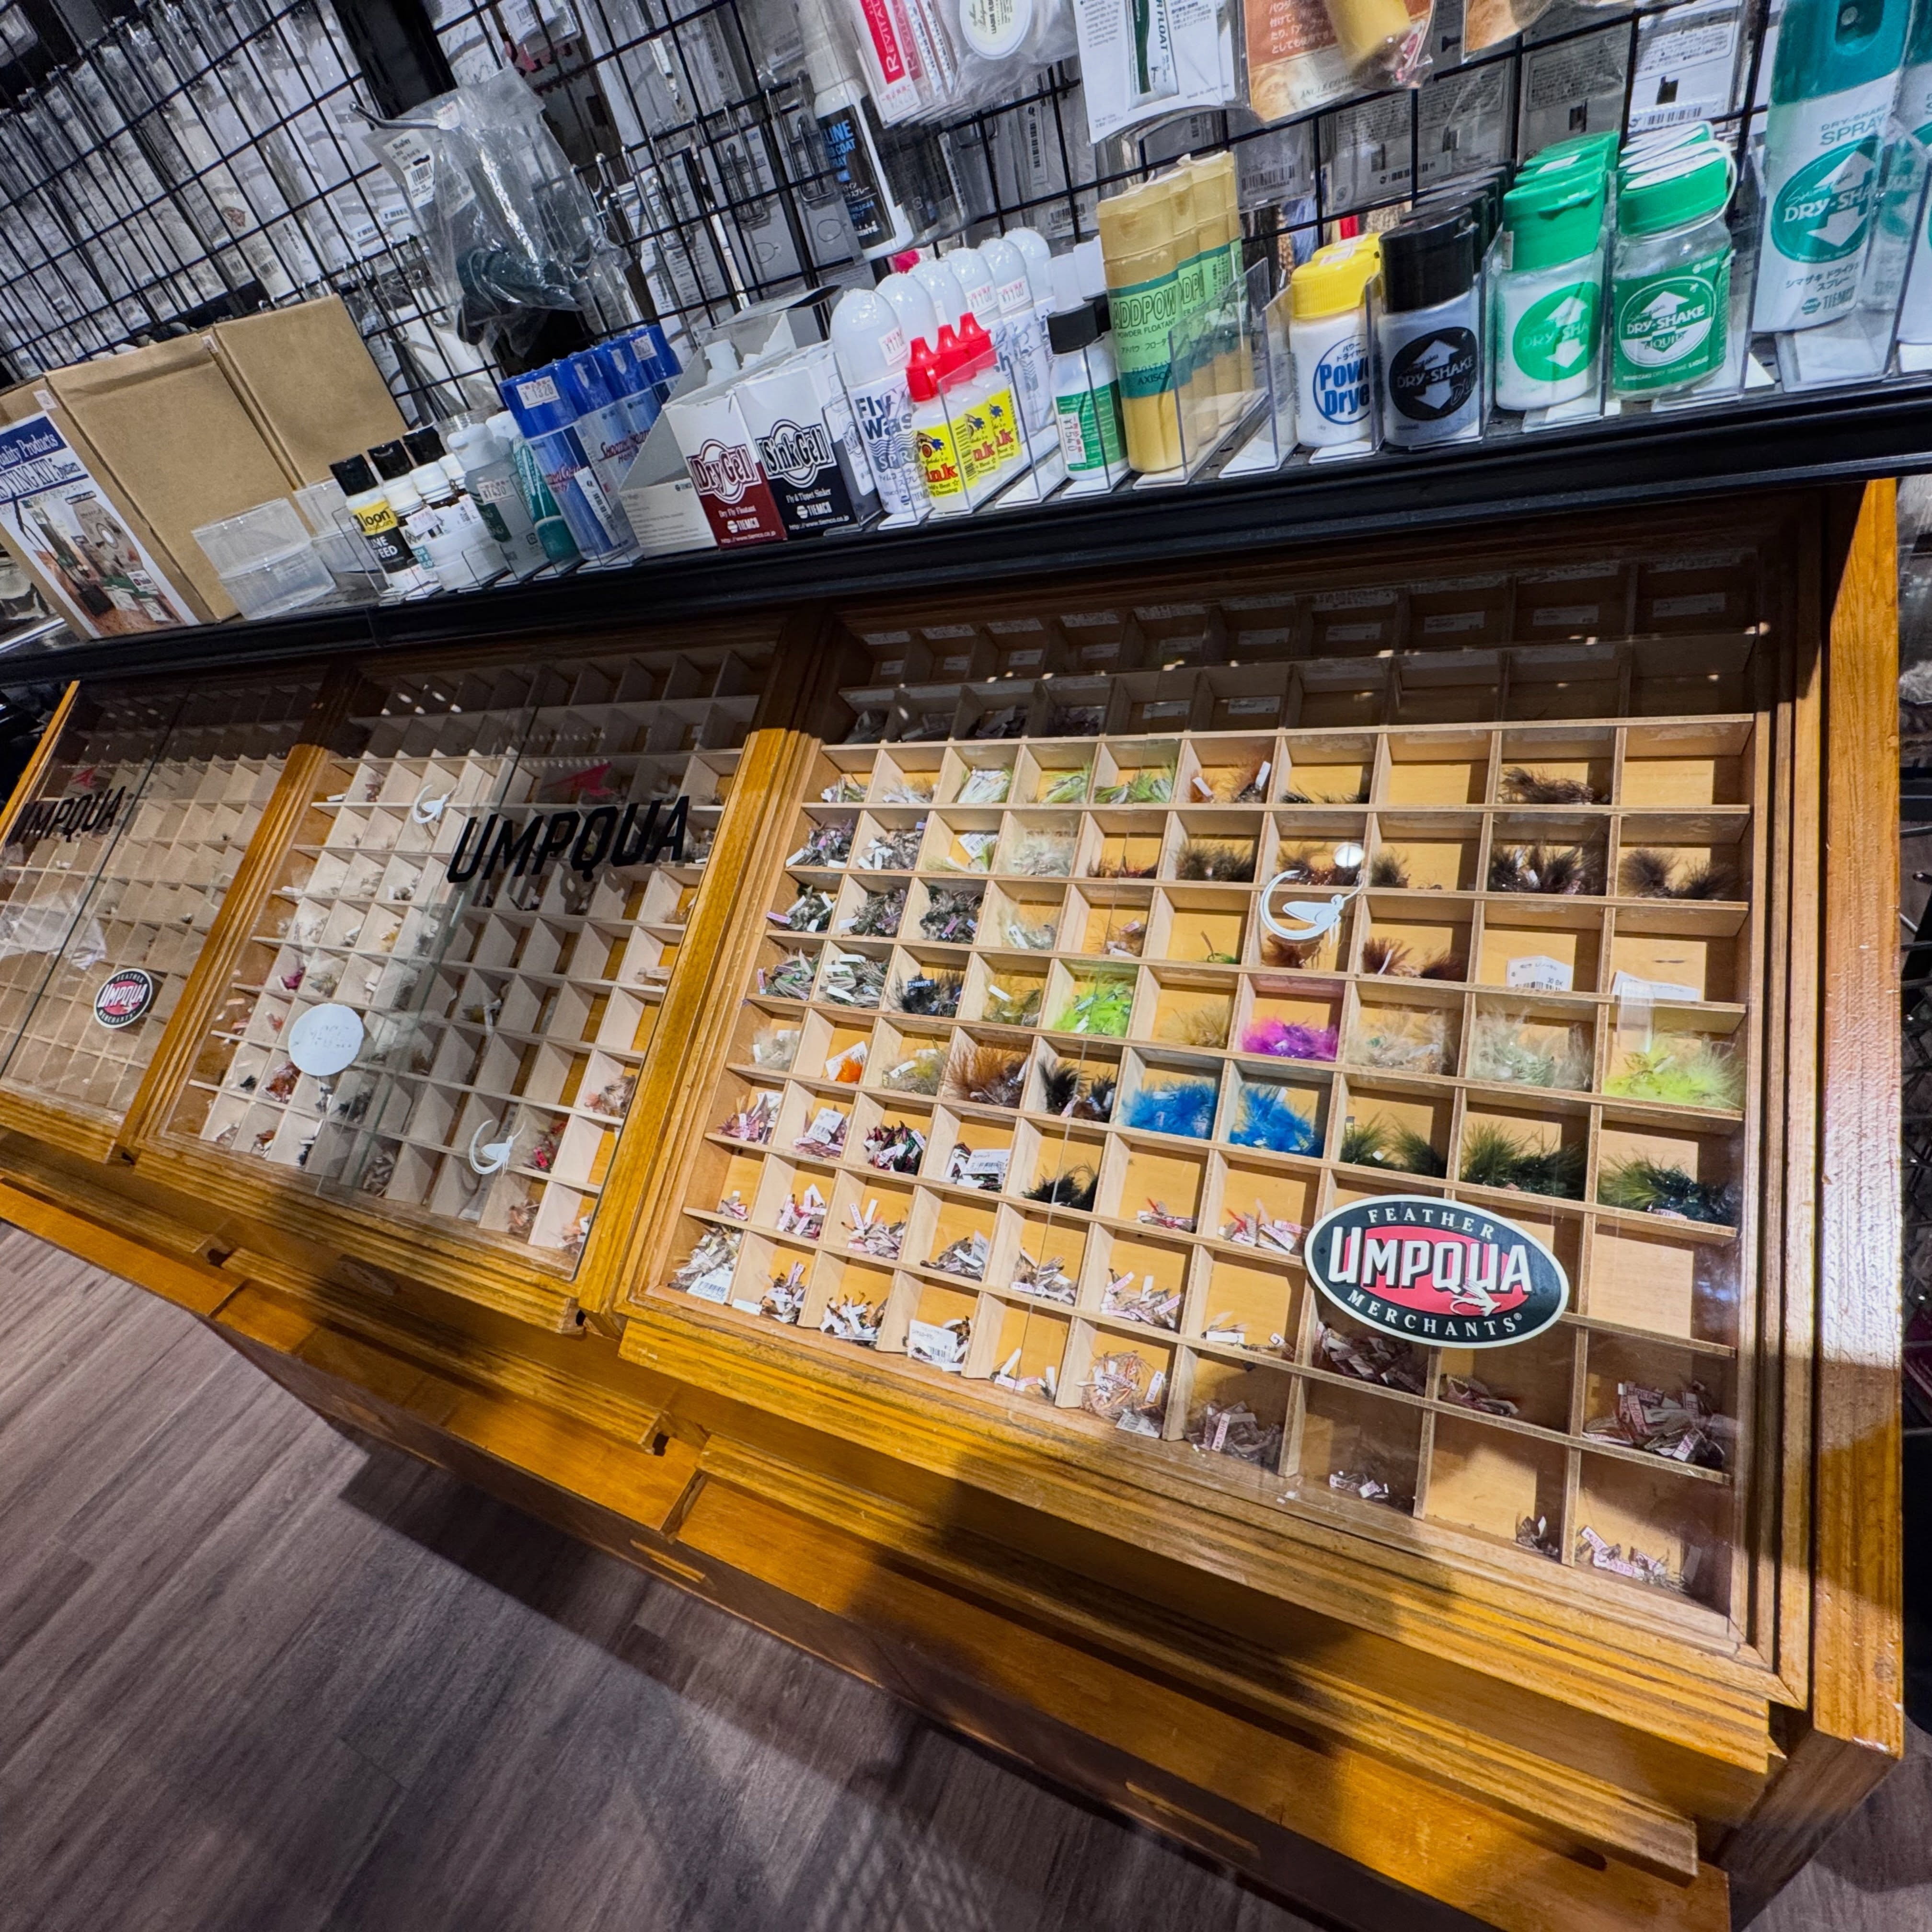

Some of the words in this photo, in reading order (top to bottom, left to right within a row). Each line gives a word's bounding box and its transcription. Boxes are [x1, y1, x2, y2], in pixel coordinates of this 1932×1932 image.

[1156, 11, 1168, 51] FLOAT
[1819, 114, 1886, 146] SPRAY
[1626, 304, 1706, 335] DRY-SHAKE
[1641, 330, 1688, 350] LIQUID
[1396, 355, 1472, 389] DRY-SHAKE
[854, 395, 892, 421] Fly
[1324, 383, 1370, 416] Drye
[861, 413, 913, 440] Was
[1063, 418, 1077, 452] ¥1540
[16, 431, 59, 458] Products
[358, 509, 391, 527] loon
[736, 517, 760, 531] TIEMCO
[806, 501, 833, 516] TIEMCO
[4, 785, 126, 847] UMPQUA
[447, 795, 690, 883] UMPQUA
[97, 983, 148, 1008] UMPQUA
[1367, 1207, 1495, 1240] FEATHER
[1328, 1226, 1533, 1294] UMPQUA
